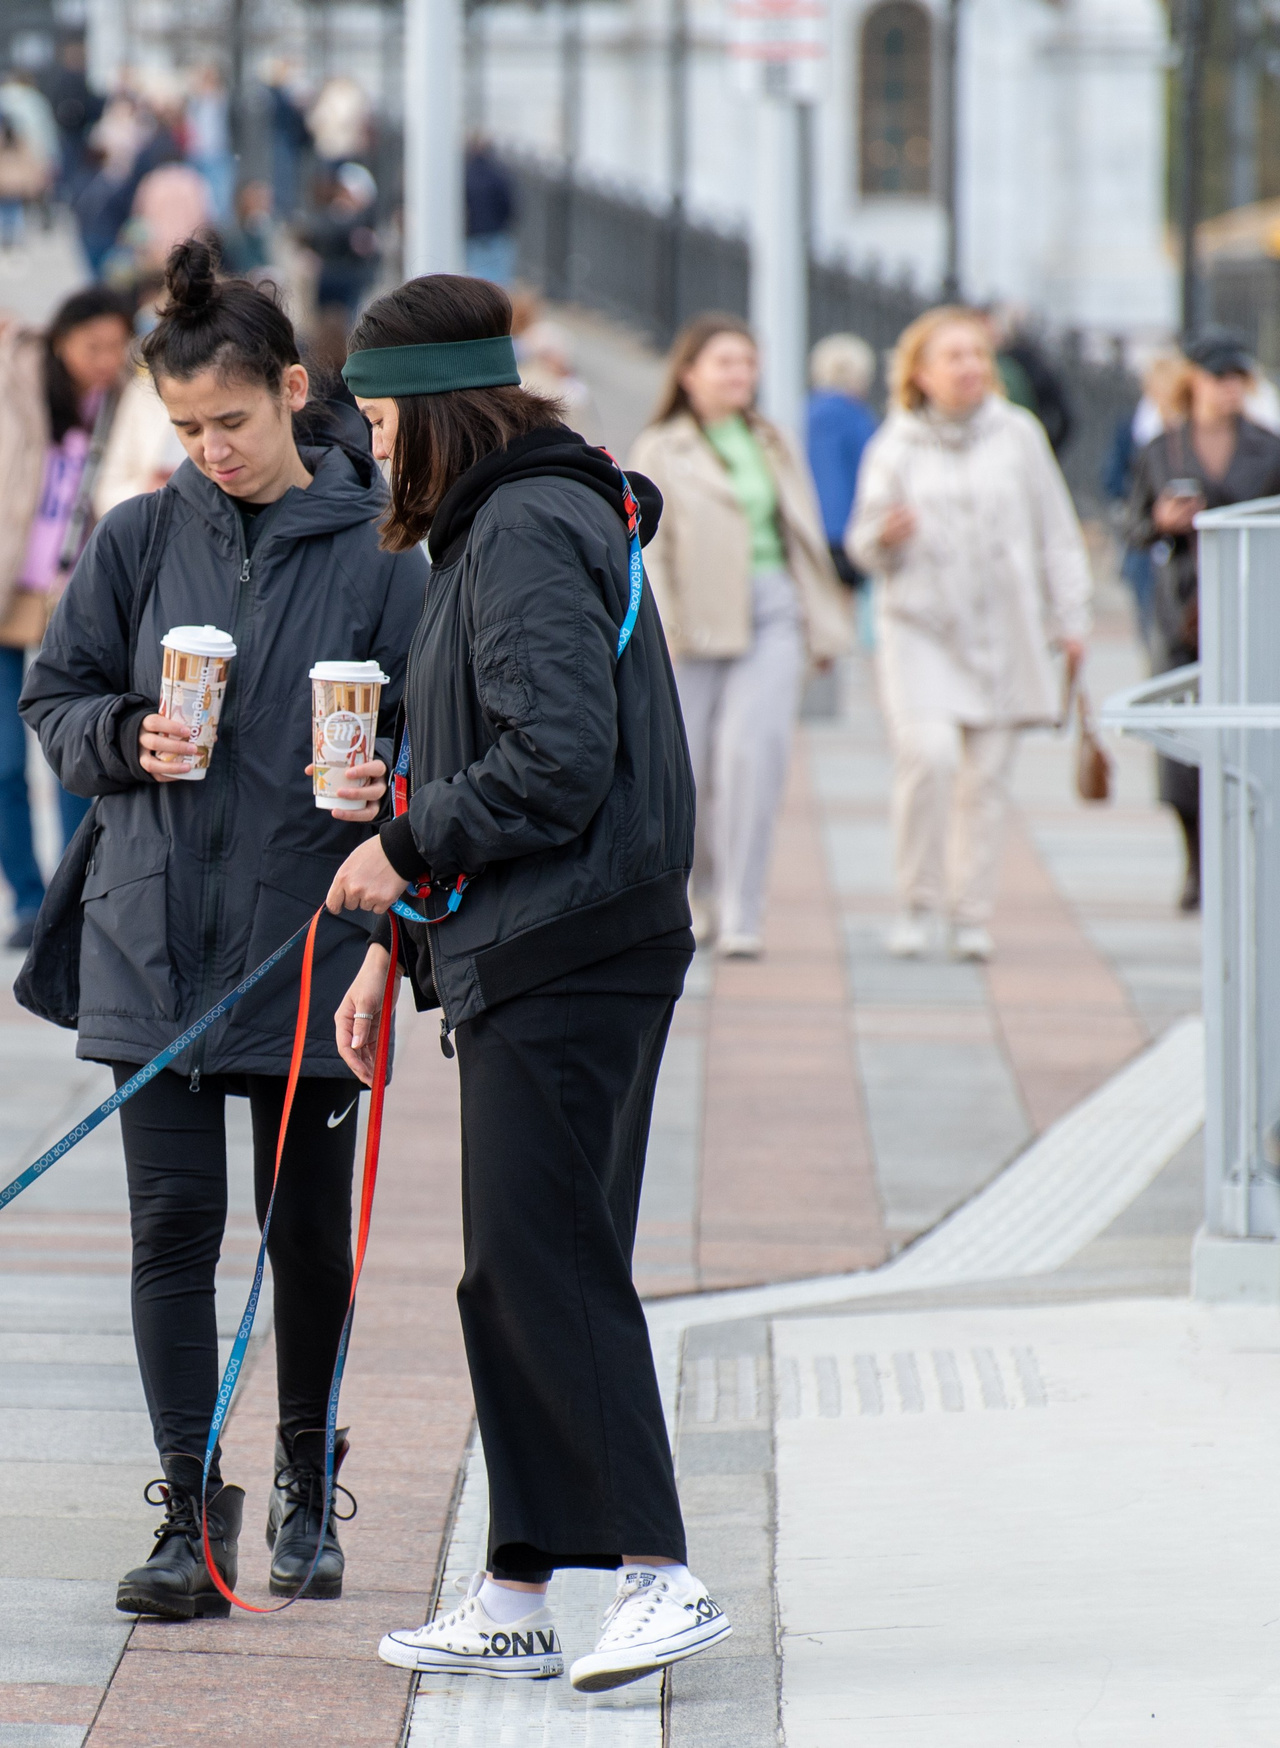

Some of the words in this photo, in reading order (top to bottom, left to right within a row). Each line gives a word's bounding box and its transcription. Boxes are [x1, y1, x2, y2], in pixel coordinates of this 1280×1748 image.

[631, 551, 640, 571] DOG
[631, 571, 640, 589] FOR
[630, 588, 640, 612] DOG
[183, 666, 210, 764] школадница
[399, 745, 411, 769] DOG
[238, 976, 258, 994] DOG
[204, 1004, 226, 1024] DOG
[187, 1023, 207, 1039] FOR
[169, 1036, 191, 1055] DOG
[136, 1063, 158, 1083] DOG
[119, 1080, 139, 1098] FOR
[100, 1095, 122, 1114] DOG
[68, 1122, 90, 1142] DOG
[51, 1139, 71, 1157] FOR
[33, 1153, 54, 1173] DOG
[1, 1181, 23, 1200] DOG
[253, 1265, 263, 1291] DOG
[247, 1292, 259, 1313] FOR
[238, 1314, 253, 1339] DOG
[224, 1358, 240, 1383] DOG
[217, 1383, 232, 1406] FOR
[331, 1377, 341, 1402] DOG
[211, 1406, 225, 1431] DOG
[329, 1404, 337, 1426] FOR
